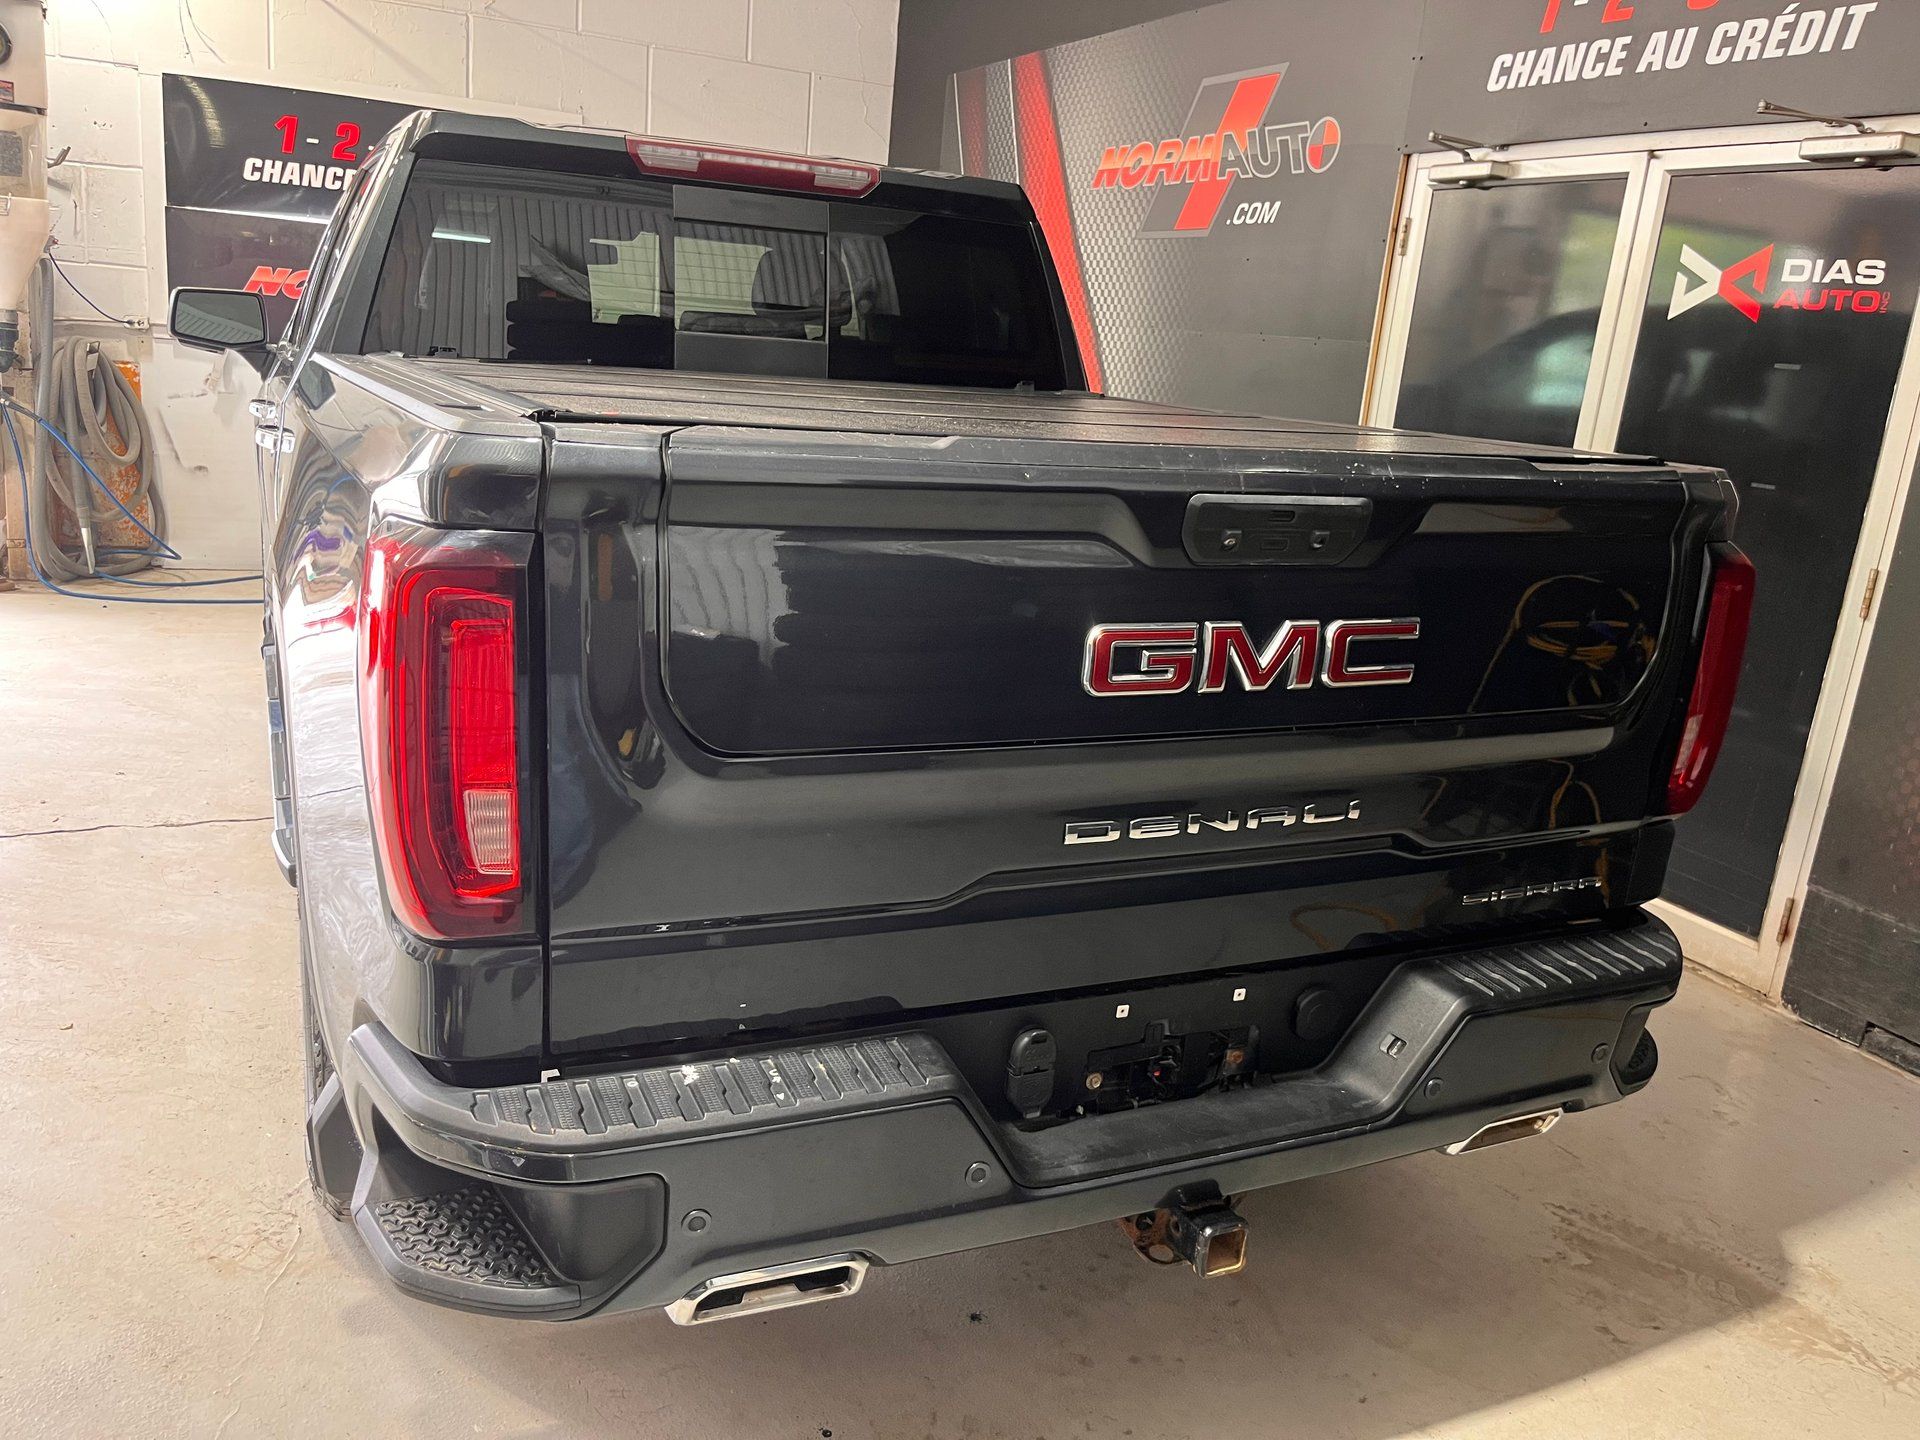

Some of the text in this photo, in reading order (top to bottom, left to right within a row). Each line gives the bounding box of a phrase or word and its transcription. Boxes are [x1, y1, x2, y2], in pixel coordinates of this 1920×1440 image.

[1486, 2, 1879, 93] CHANCE AU CRÉDIT
[274, 114, 298, 154] 1
[331, 121, 361, 161] 2
[1226, 201, 1282, 226] .COM
[1781, 258, 1887, 285] DIAS
[1773, 287, 1882, 314] AUTO
[1081, 616, 1421, 698] GMC
[1063, 799, 1362, 846] DENALI
[1461, 876, 1602, 906] SIERRA
